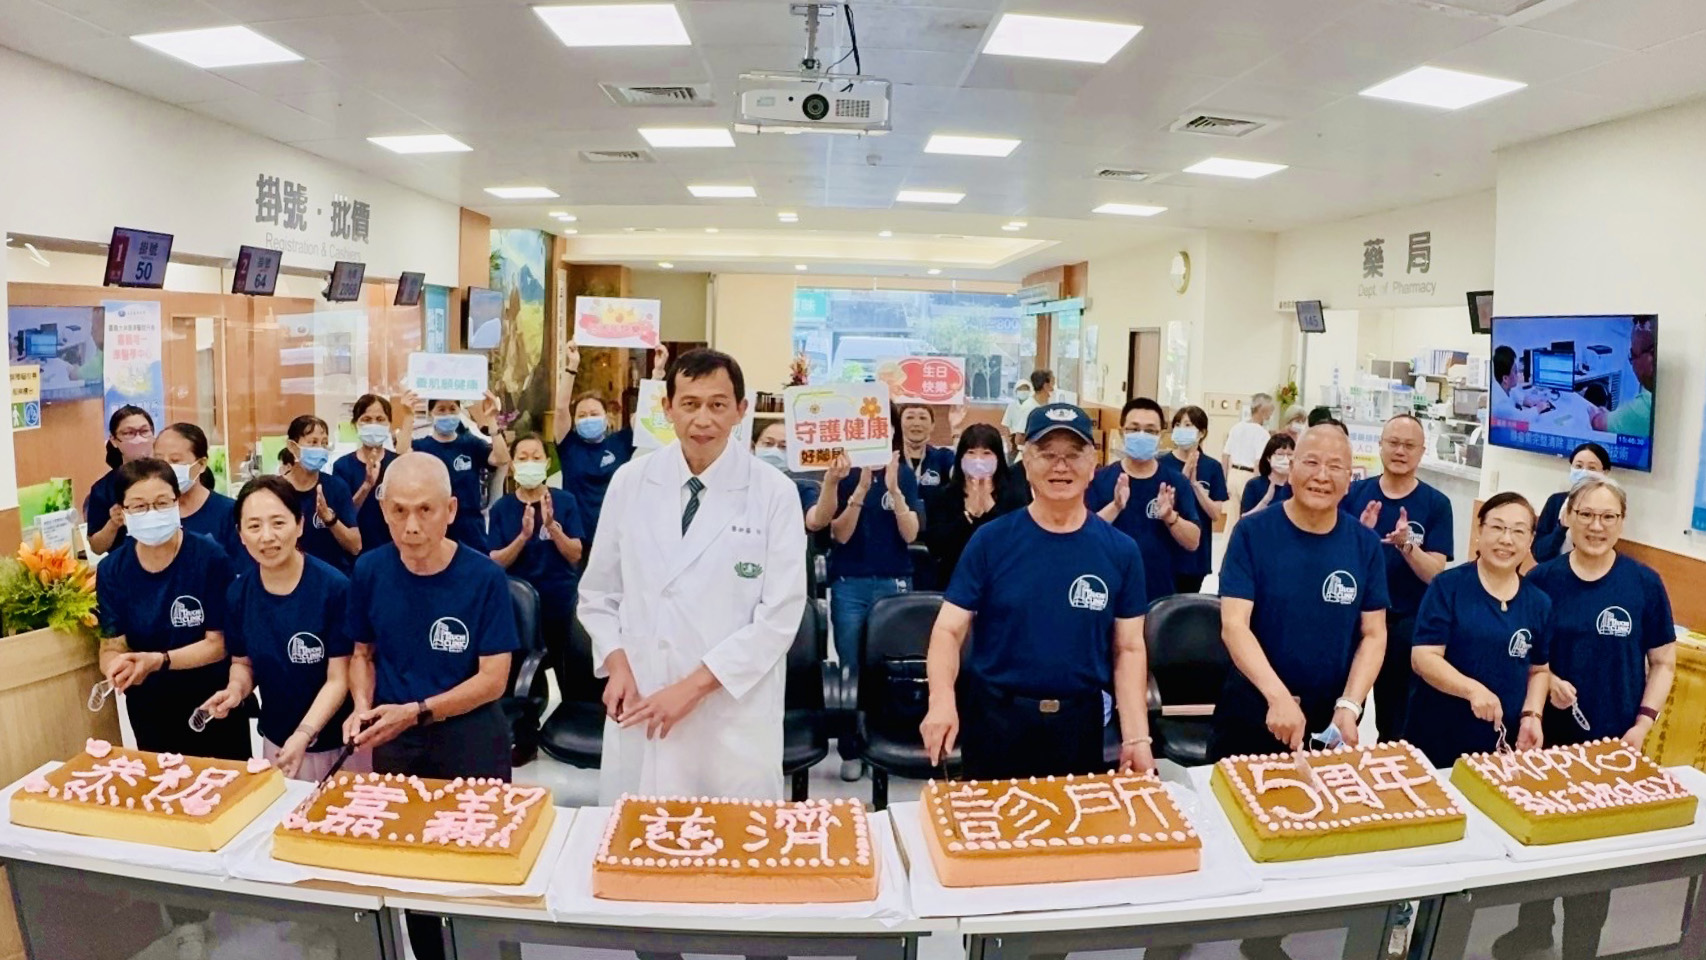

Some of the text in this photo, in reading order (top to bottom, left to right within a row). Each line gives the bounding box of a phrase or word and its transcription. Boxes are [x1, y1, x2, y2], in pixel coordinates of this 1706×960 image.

[265, 232, 319, 256] Registration
[135, 262, 153, 280] 50
[254, 273, 267, 289] 64
[1392, 281, 1437, 298] Pharmacy
[923, 366, 948, 378] 生日
[922, 380, 948, 393] 快樂
[795, 416, 889, 444] 守護健康
[1469, 747, 1602, 782] HAPPY
[1248, 752, 1432, 821] 5周年
[945, 777, 1168, 840] 診所
[629, 806, 842, 862] 慈濟
